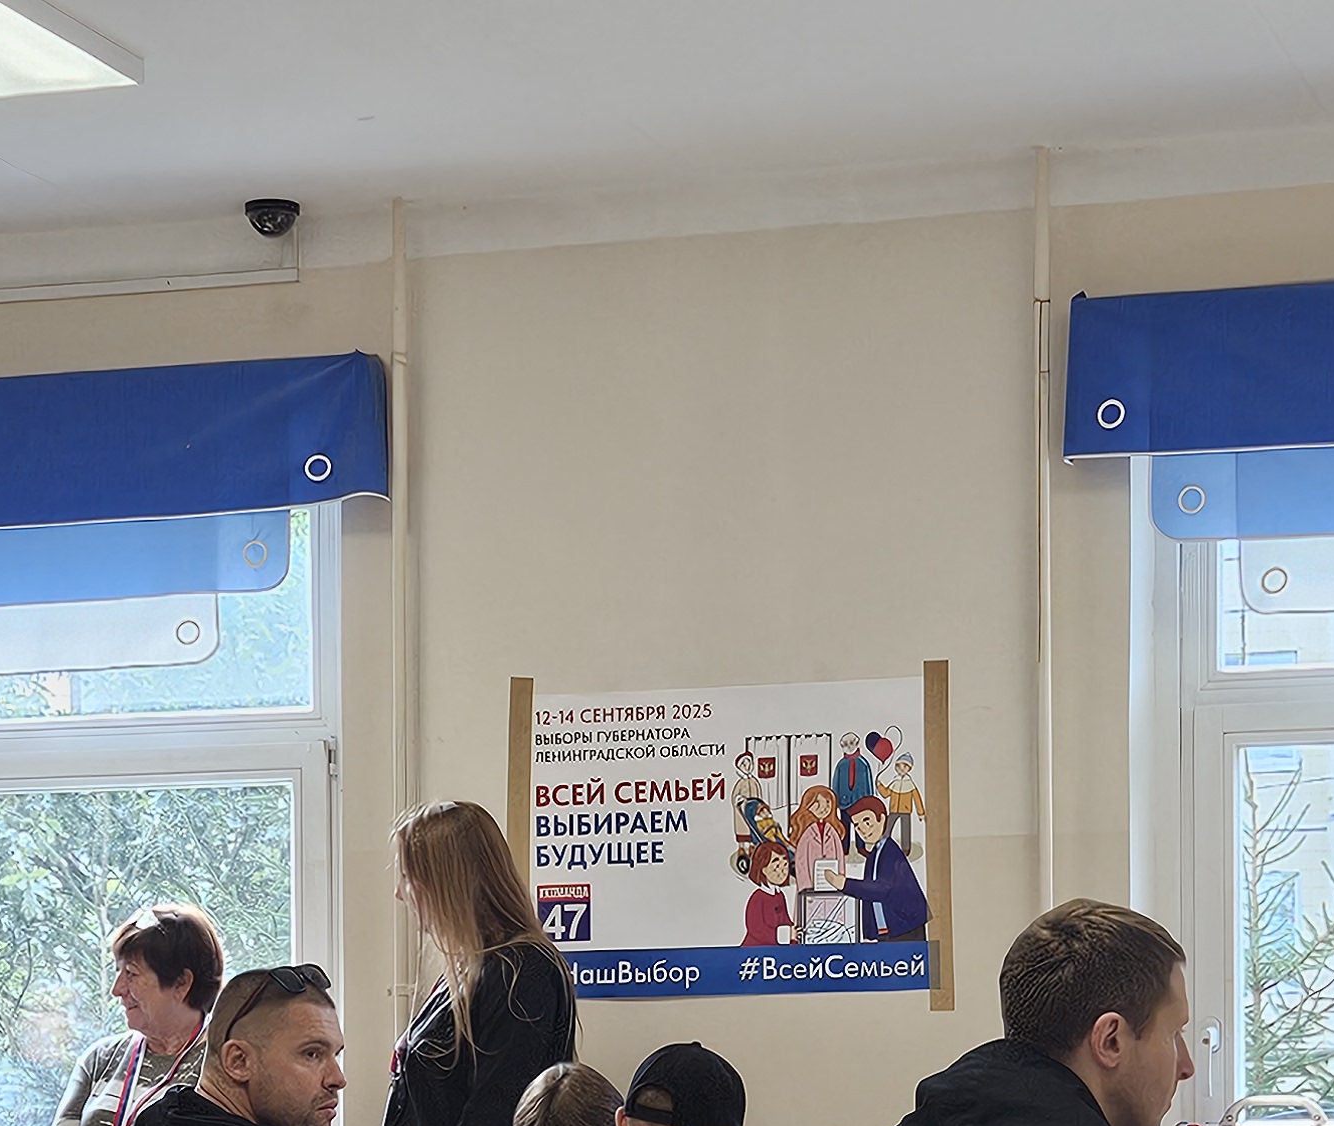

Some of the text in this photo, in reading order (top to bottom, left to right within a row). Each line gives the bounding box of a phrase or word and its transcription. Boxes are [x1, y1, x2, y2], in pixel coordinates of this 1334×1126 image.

[535, 704, 712, 725] 12-14 СЕНТЯБРЯ 2025
[535, 727, 690, 746] ВЫБОРЫ ГУБЕРНАТОРА
[535, 743, 726, 763] ЛЕНИНГРАДСКОЙ ОБЛАСТИ
[536, 772, 725, 807] ВСЕЙ СЕМЬЕЙ
[536, 810, 688, 837] ВЫБИРАЕМ
[536, 841, 664, 870] БУДУЩЕЕ
[543, 904, 587, 939] 47
[739, 954, 925, 981] #ВсейСемьей
